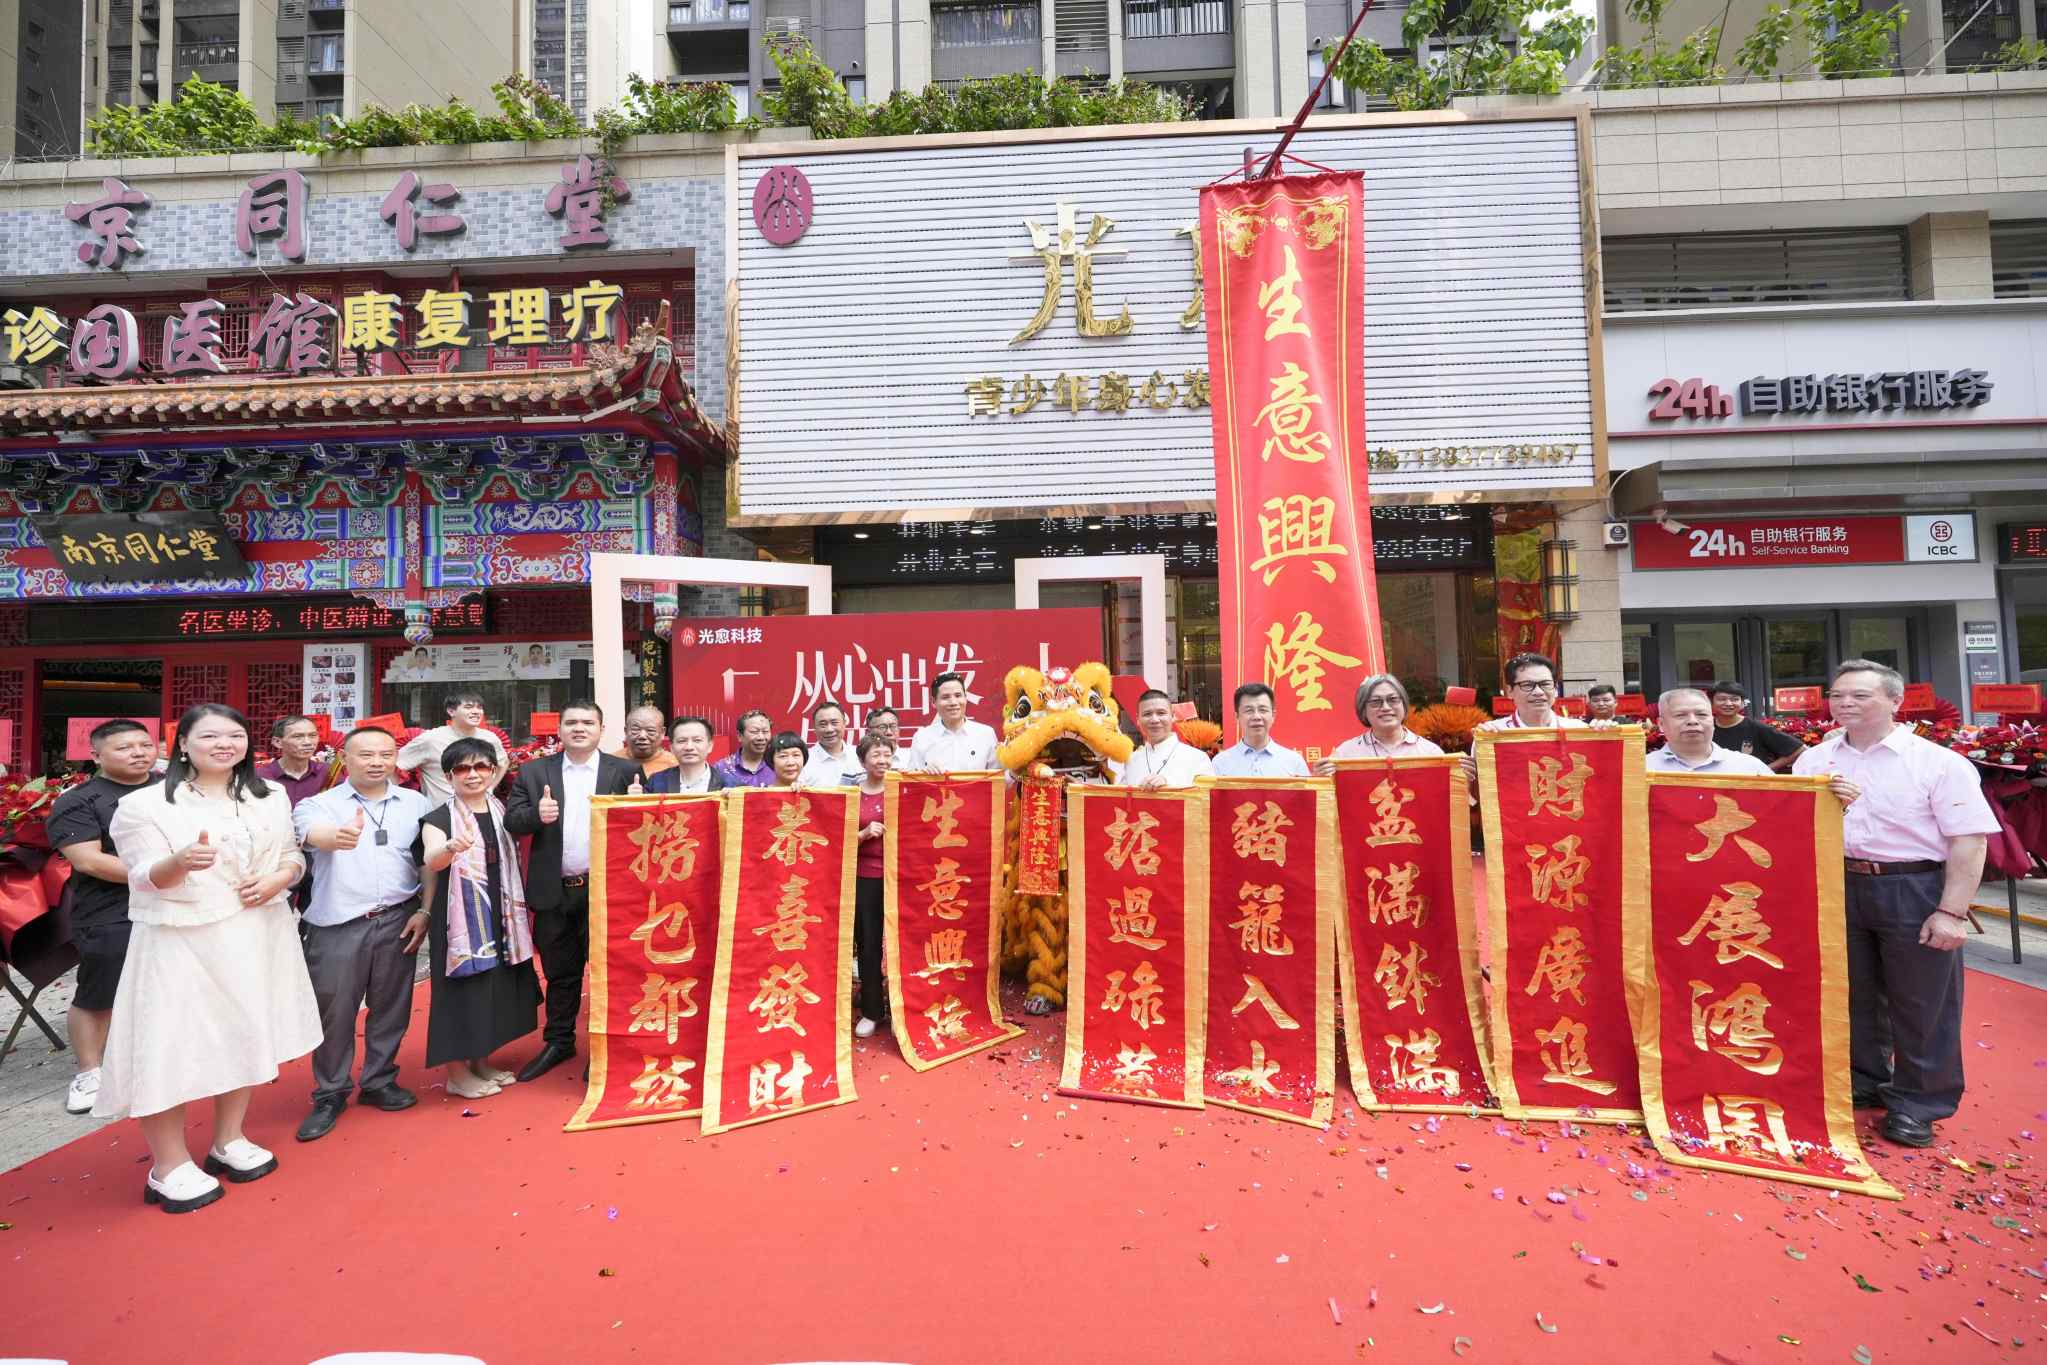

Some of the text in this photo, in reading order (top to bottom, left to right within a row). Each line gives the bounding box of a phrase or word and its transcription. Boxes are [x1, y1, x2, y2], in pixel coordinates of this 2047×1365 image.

[65, 153, 632, 268] 京同仁堂
[2, 305, 68, 366] 诊
[70, 292, 338, 378] 国医馆
[342, 280, 625, 351] 康复理疗
[1648, 367, 1995, 421] 24h 自助银行服务
[1250, 245, 1363, 713] 生意興隆
[62, 529, 221, 565] 南京同仁堂
[1689, 527, 1849, 558] 24h 自助银行服务
[1751, 544, 1849, 556] Self-Service Banking
[1927, 546, 1958, 556] ICBC
[698, 627, 763, 645] 光愈科技
[788, 642, 985, 716] 从心出发
[1524, 752, 1618, 1096] 財源廣進
[748, 802, 829, 1114] 恭喜發財
